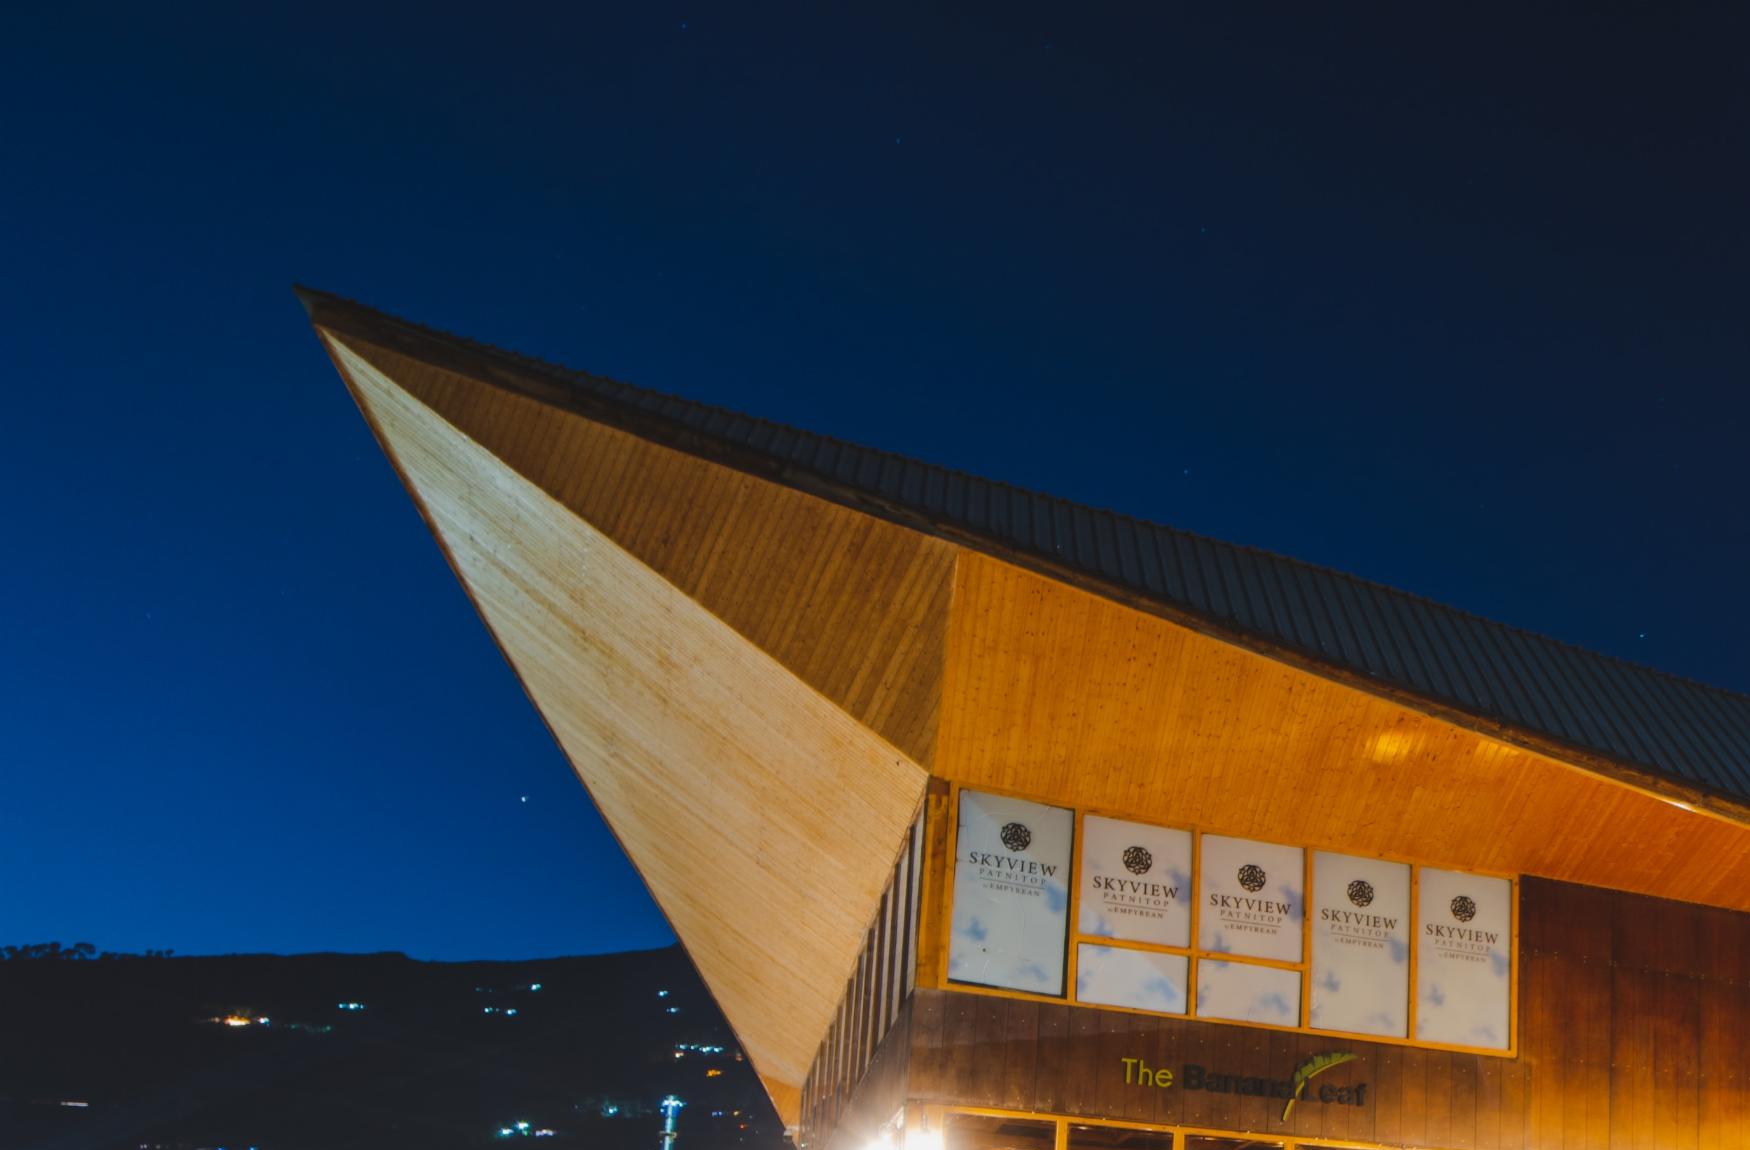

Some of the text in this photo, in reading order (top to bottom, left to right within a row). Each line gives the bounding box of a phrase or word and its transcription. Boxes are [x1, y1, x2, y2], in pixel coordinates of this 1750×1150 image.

[969, 851, 1057, 877] SKYVIEW
[979, 868, 1047, 886] PATNITOP
[1092, 875, 1179, 899] SKYVIEW
[1103, 892, 1170, 908] PATNITOP
[1210, 893, 1292, 916] SKYVIEW
[1114, 906, 1164, 919] EMPYREAN
[1220, 909, 1283, 924] PATNITOP
[1321, 908, 1398, 930] SKYVIEW
[1330, 923, 1389, 938] PATNITOP
[1425, 923, 1499, 945] SKYVIEW
[1434, 938, 1490, 953] PATNITOP
[1121, 1057, 1367, 1107] The Banana Leaf
